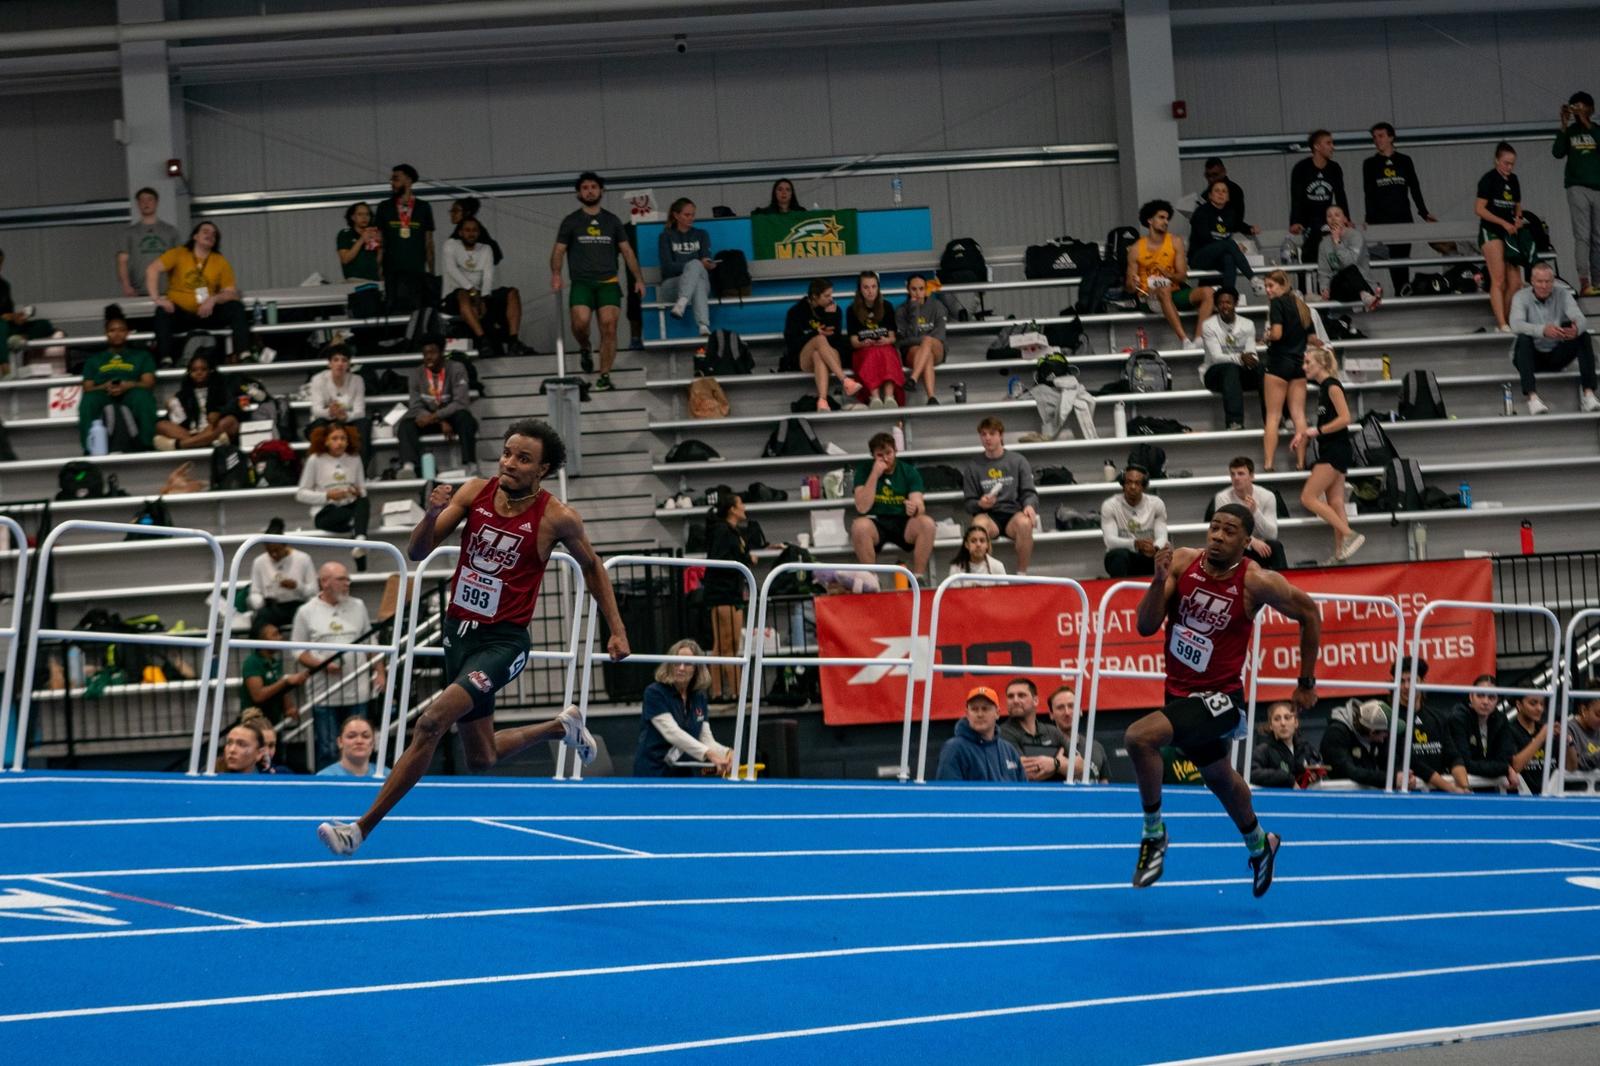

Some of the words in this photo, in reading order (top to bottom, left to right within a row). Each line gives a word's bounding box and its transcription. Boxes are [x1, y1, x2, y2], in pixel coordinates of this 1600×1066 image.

[776, 241, 844, 259] MASON
[462, 584, 490, 609] 593
[848, 635, 1033, 685] A10
[1177, 640, 1202, 665] 598
[1209, 694, 1229, 711] 3
